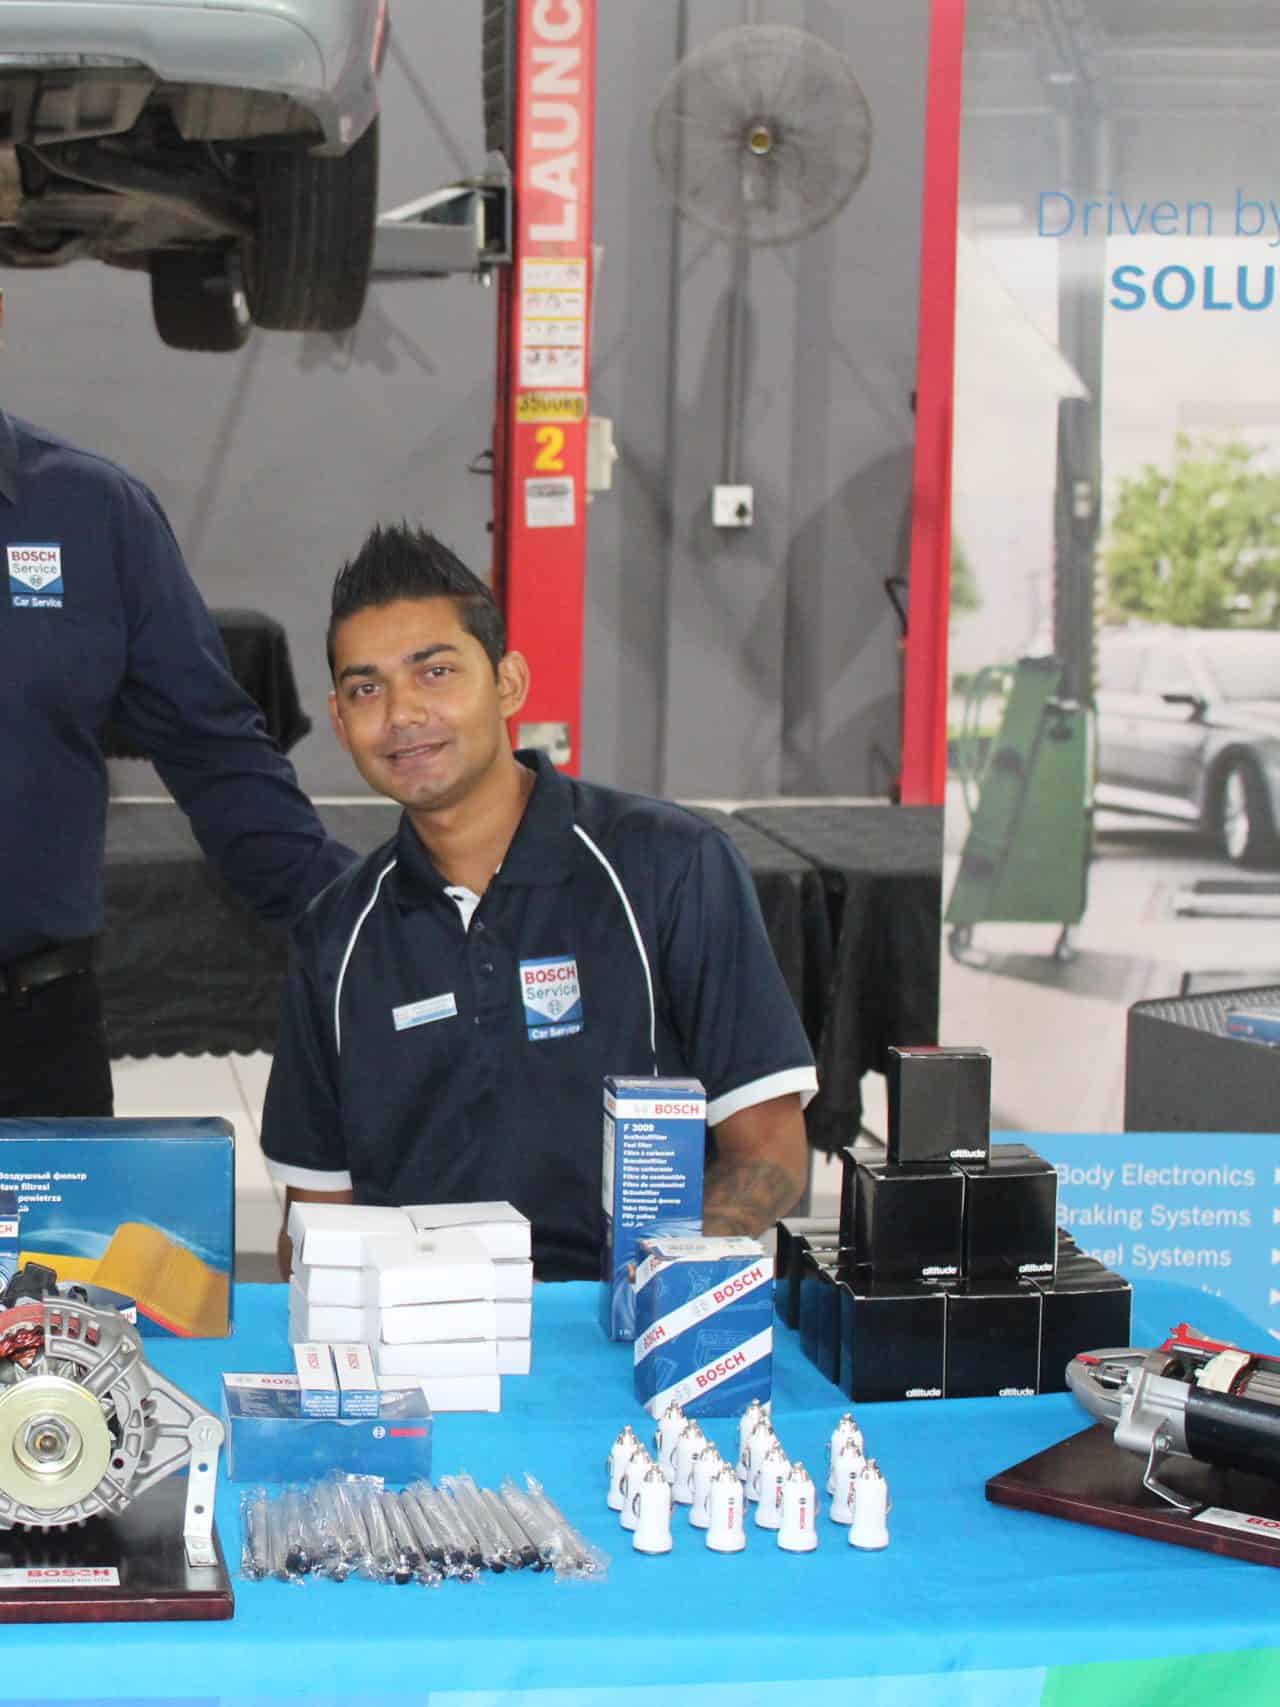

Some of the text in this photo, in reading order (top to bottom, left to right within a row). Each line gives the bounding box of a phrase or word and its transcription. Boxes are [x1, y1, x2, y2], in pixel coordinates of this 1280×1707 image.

[1037, 190, 1215, 238] Driven
[1110, 264, 1276, 311] SOLU
[534, 426, 565, 471] 2
[11, 551, 56, 561] BOSCH
[12, 563, 57, 574] Service
[524, 965, 577, 985] BOSCH
[526, 983, 578, 1001] Service
[654, 1103, 700, 1115] BOSCH
[1056, 1163, 1257, 1190] Body Electronics
[1056, 1204, 1253, 1231] Braking Systems
[1131, 1244, 1233, 1270] Systems
[712, 1266, 764, 1304] BOSCH
[695, 1351, 747, 1388] BOSCH
[27, 1568, 111, 1577] BOSCH
